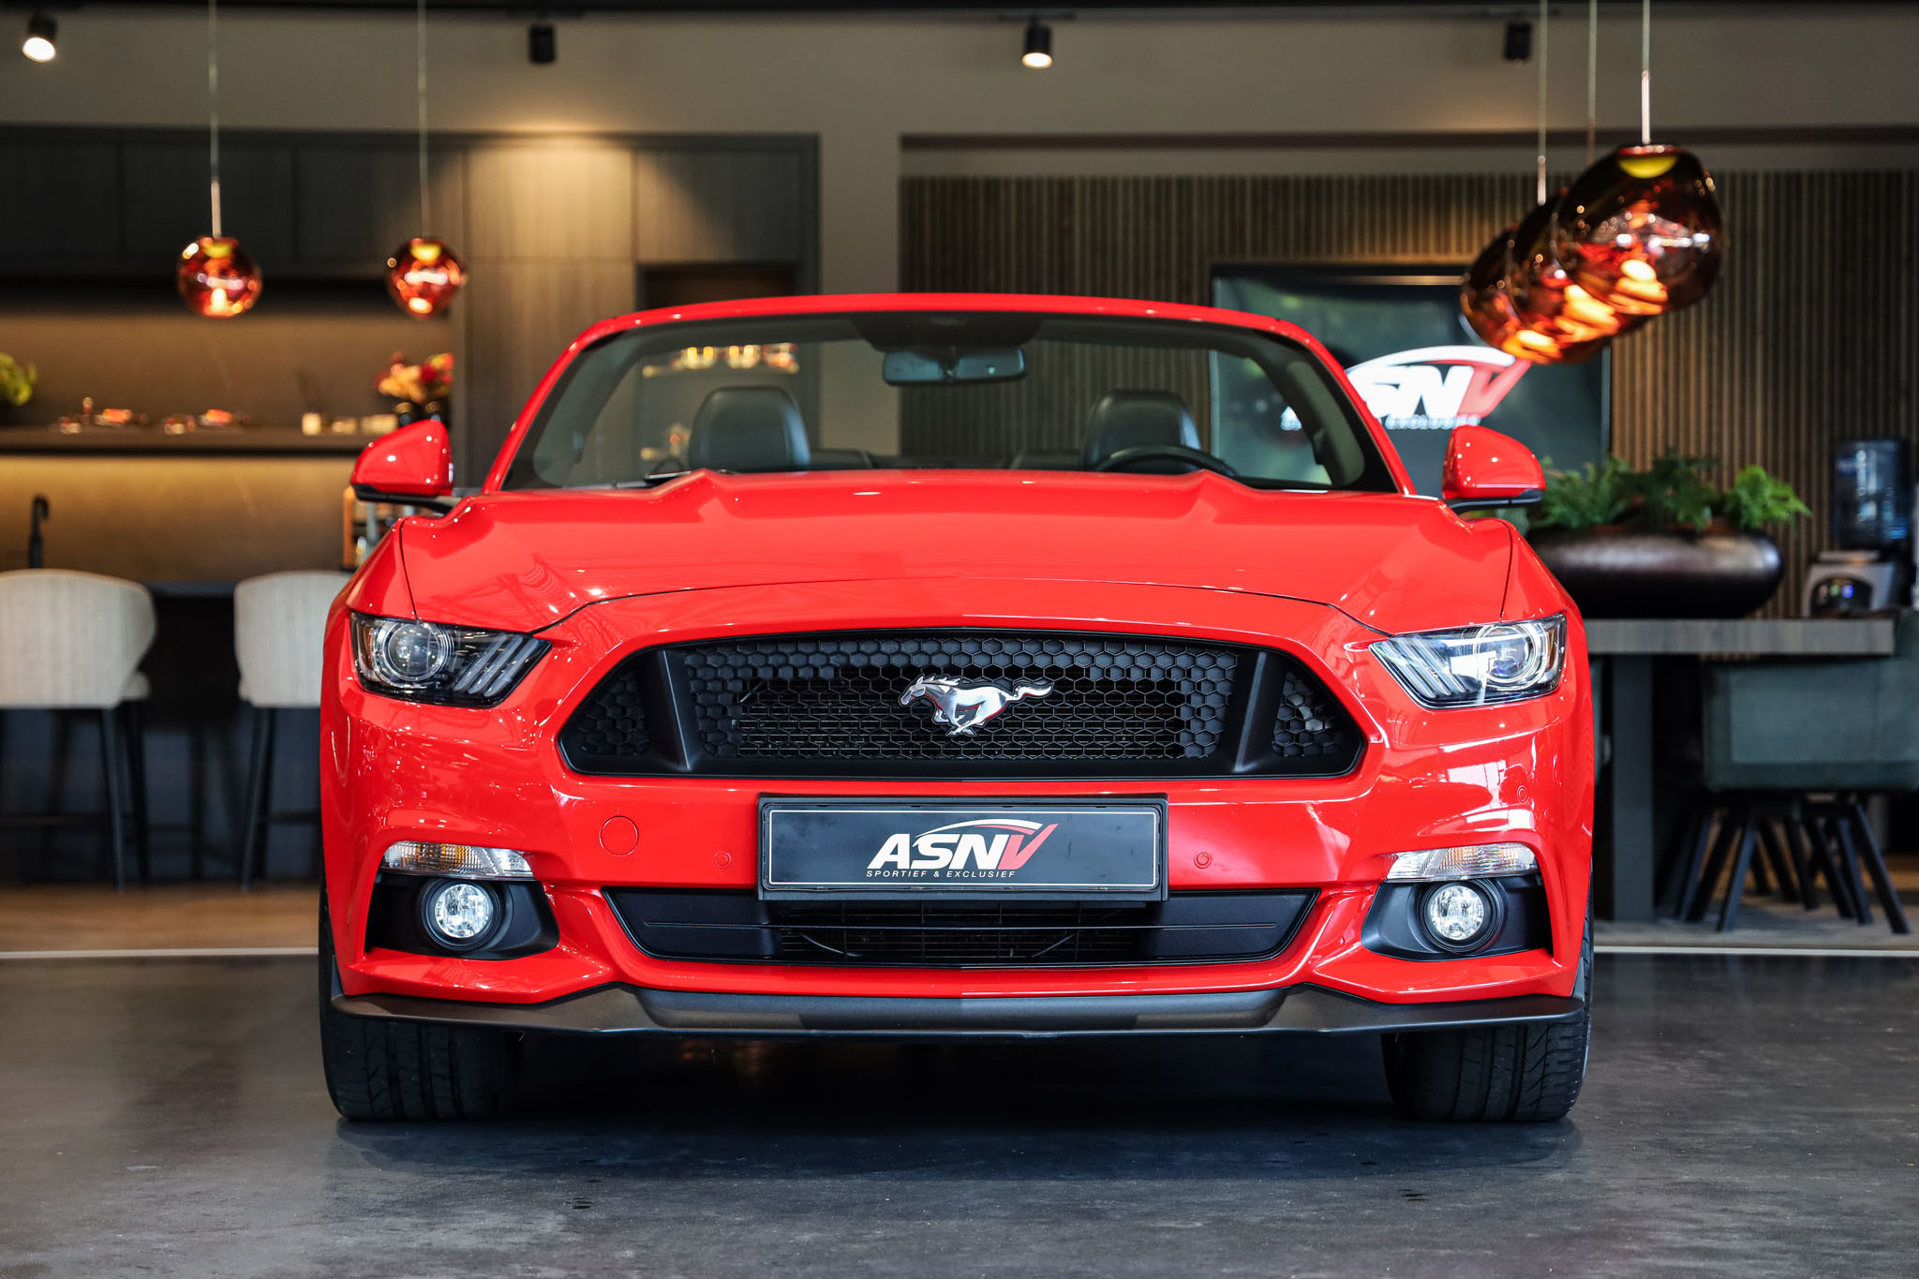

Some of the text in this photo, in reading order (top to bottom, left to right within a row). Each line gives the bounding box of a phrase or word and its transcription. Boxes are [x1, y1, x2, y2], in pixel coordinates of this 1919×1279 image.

[1347, 353, 1531, 419] SNV
[867, 822, 1059, 870] ASNV
[866, 870, 1016, 878] SPORTIEF & EXCLUSIEF
